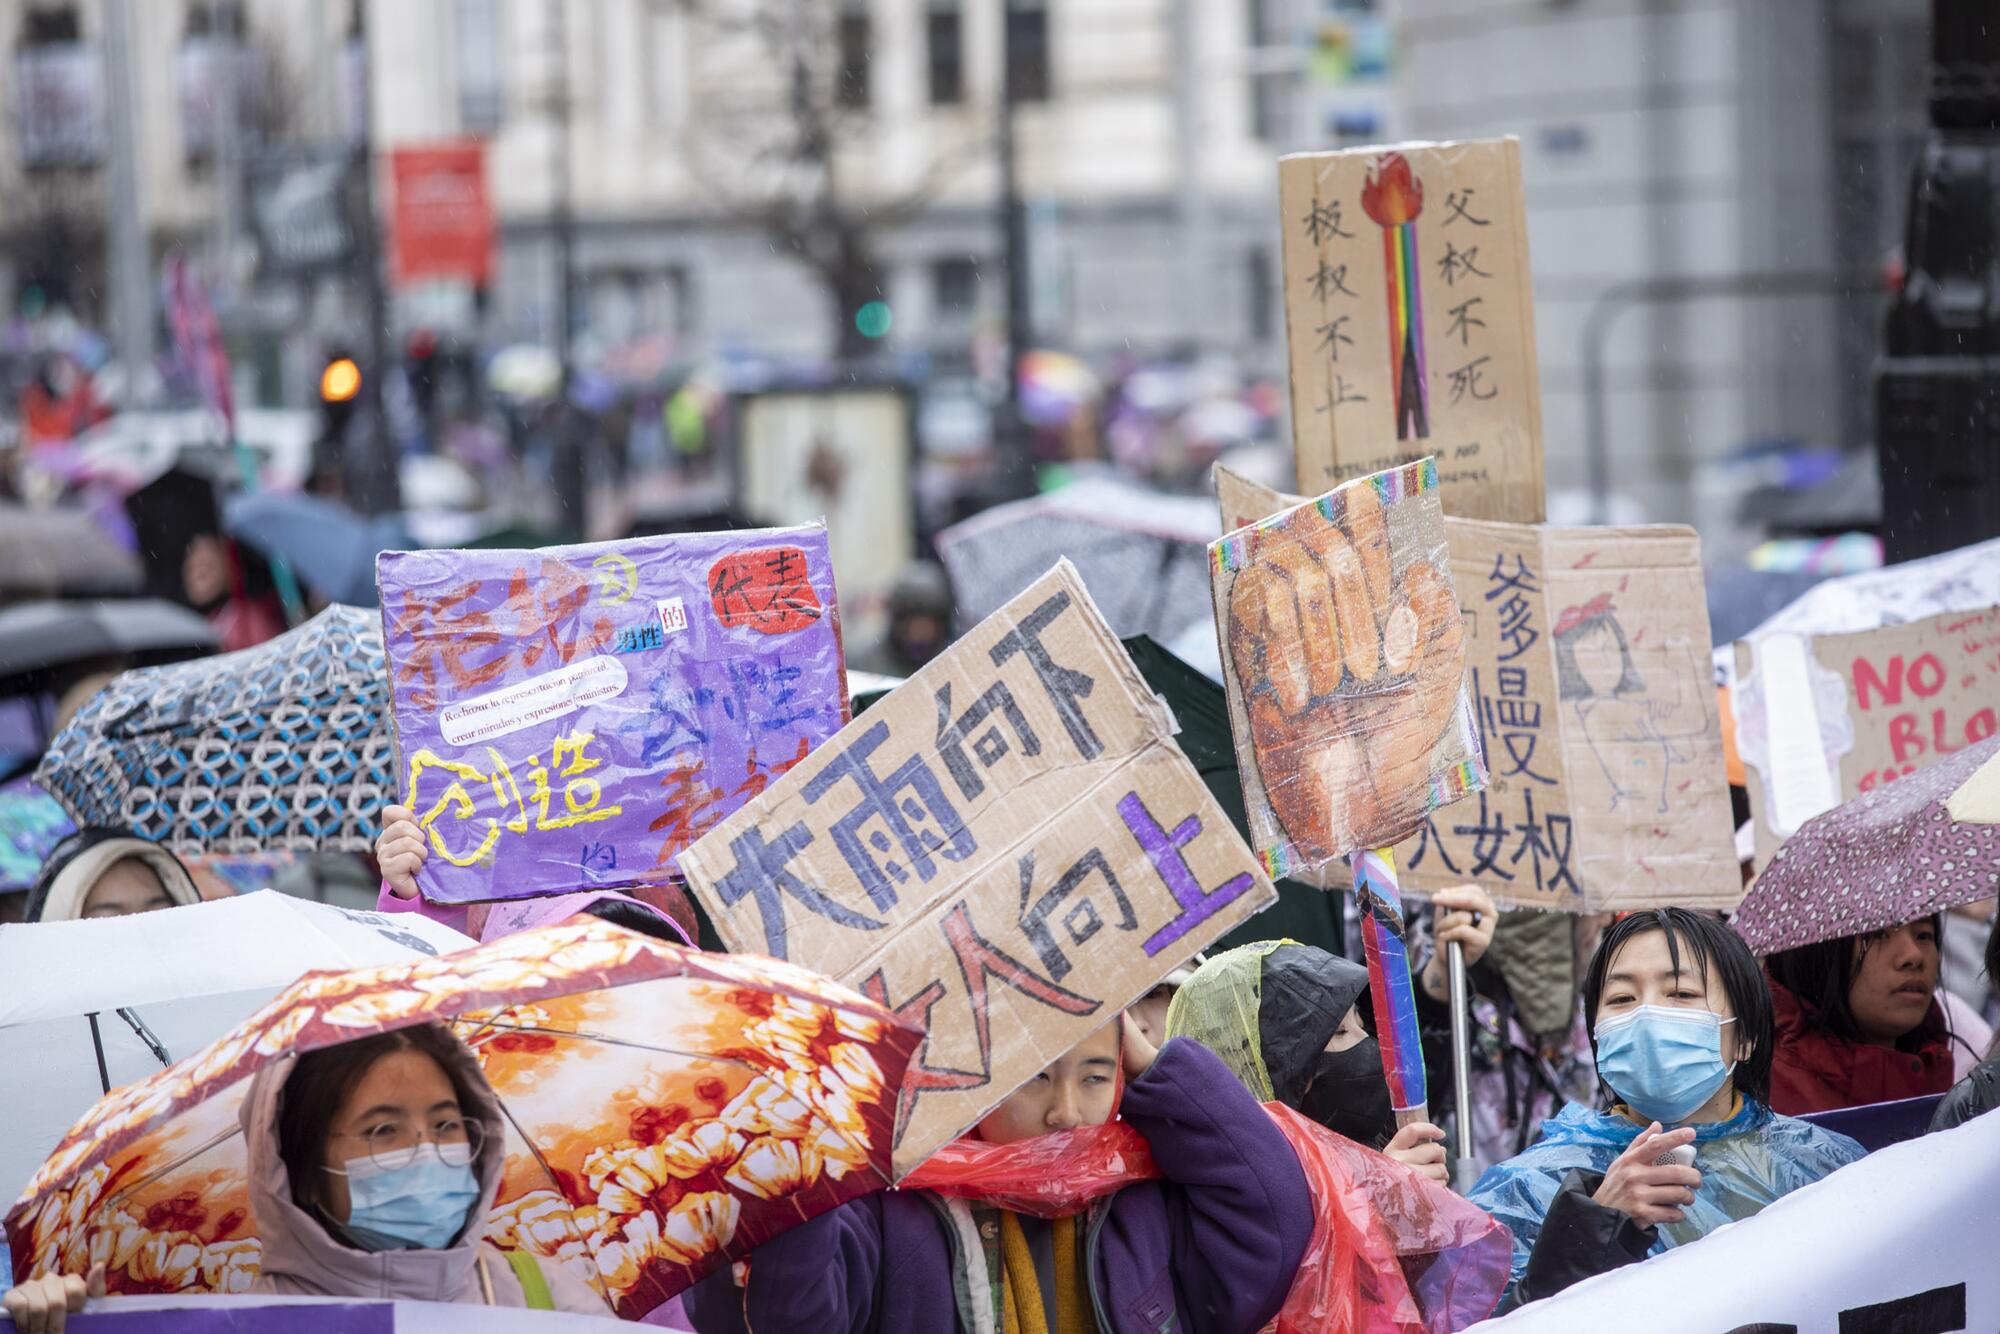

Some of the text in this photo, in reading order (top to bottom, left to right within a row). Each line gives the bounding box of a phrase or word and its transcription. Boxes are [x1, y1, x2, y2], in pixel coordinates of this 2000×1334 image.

[710, 551, 822, 622] 代表
[617, 624, 662, 650] 男性
[662, 606, 686, 629] 的
[1852, 652, 1947, 710] NO
[444, 703, 490, 723] Rechazar
[404, 727, 622, 867] 创造
[713, 590, 1106, 960] 大雨向下
